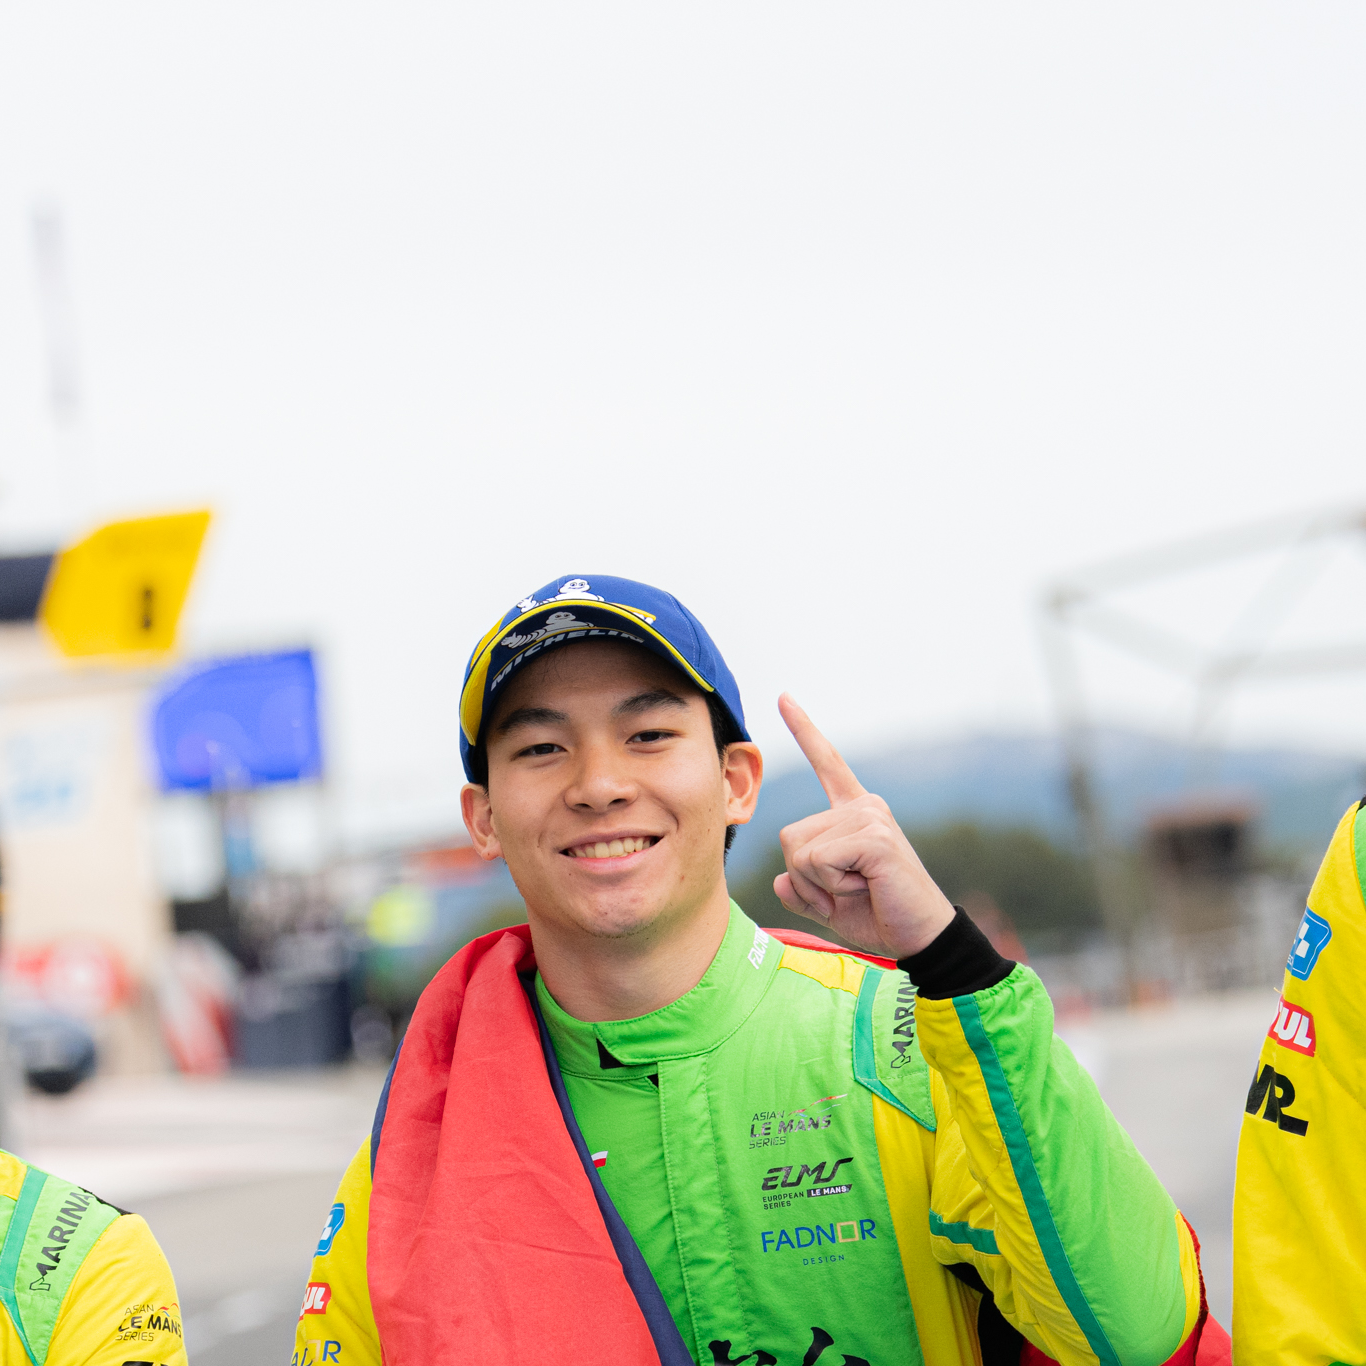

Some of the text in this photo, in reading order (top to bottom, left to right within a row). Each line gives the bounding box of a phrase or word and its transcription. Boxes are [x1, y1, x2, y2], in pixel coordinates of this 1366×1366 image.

[491, 630, 644, 692] MICHELIN
[752, 1111, 784, 1122] ASIAN
[750, 1115, 832, 1138] LE MANS
[749, 1136, 786, 1149] SERIES
[762, 1157, 854, 1191] ELMS
[763, 1192, 804, 1202] EUROPEAN
[824, 1186, 846, 1194] MANS
[764, 1201, 791, 1210] SERIES
[29, 1188, 92, 1292] MARINA
[761, 1219, 877, 1252] FADNOR
[803, 1255, 845, 1265] DESIGN
